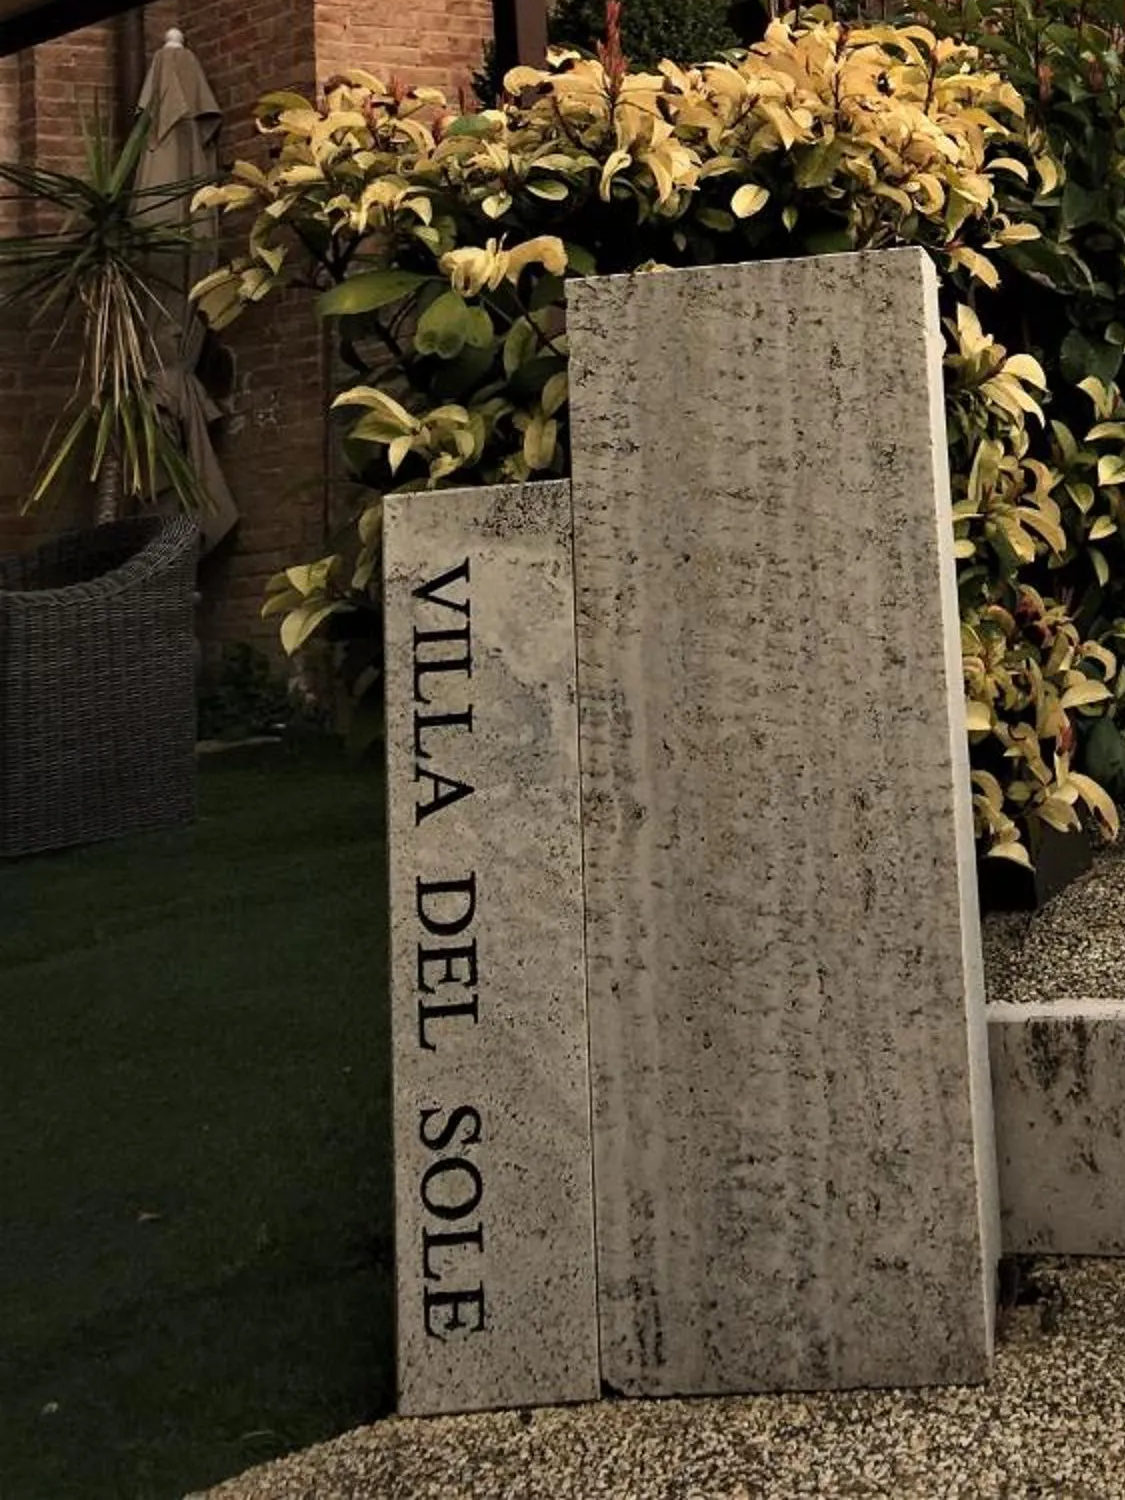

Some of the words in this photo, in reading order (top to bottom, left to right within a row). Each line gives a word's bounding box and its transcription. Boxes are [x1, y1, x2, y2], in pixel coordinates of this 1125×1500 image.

[411, 556, 475, 828] VILLA
[416, 871, 480, 1053] DEL
[418, 1104, 487, 1345] SOLE
